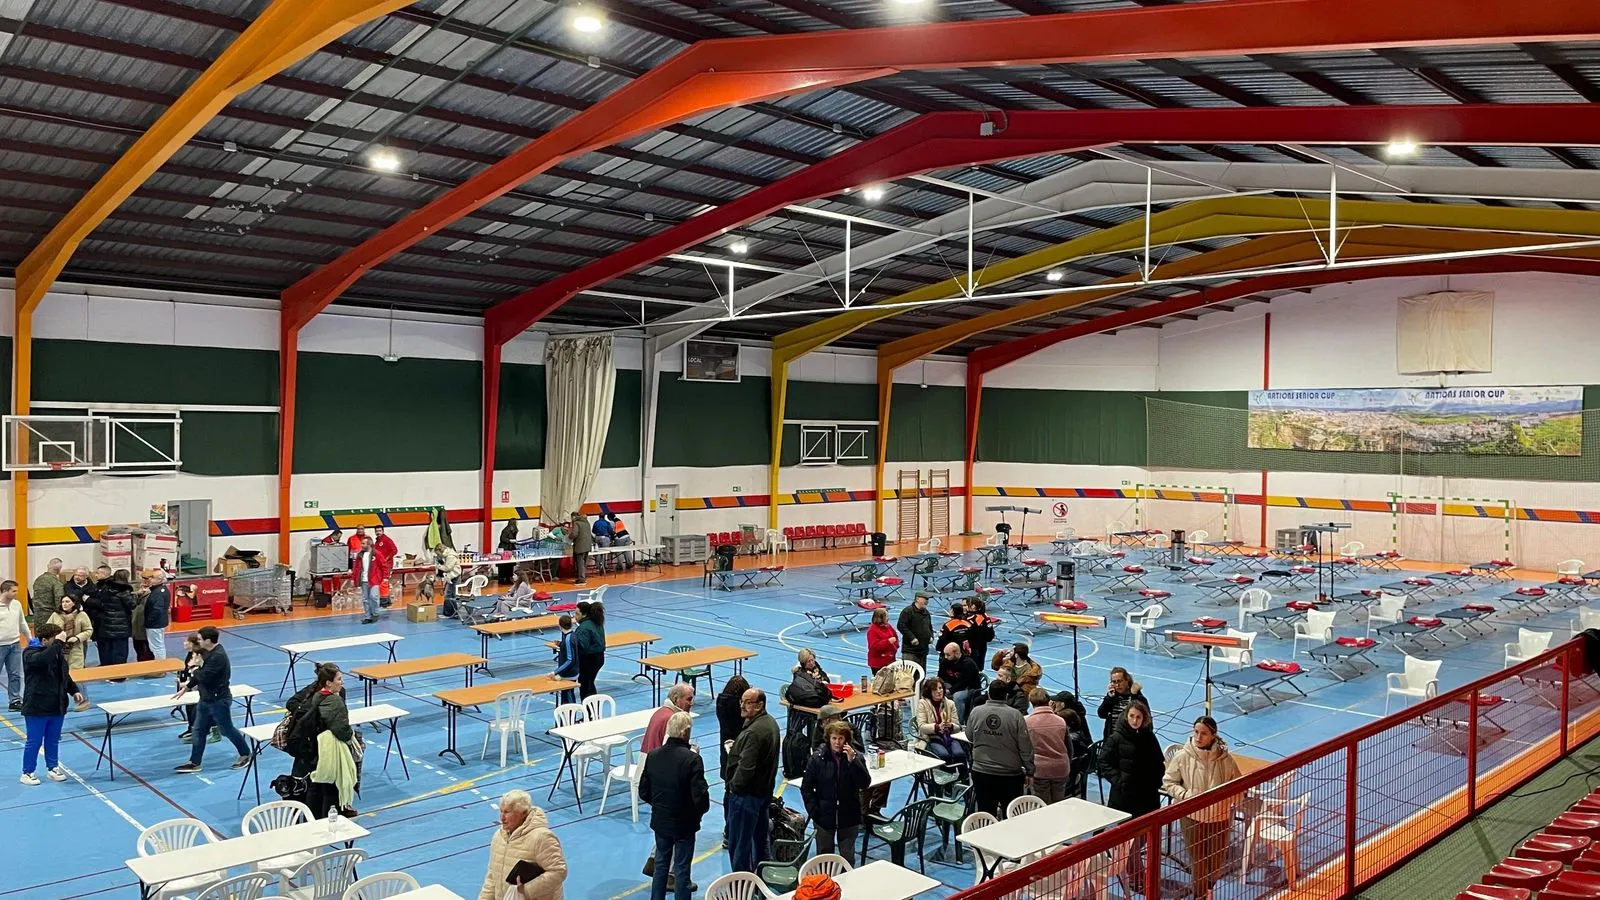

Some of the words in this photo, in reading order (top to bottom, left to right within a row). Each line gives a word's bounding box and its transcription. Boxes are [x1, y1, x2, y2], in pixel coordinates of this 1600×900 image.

[1267, 391, 1295, 399] NATIONS
[1296, 391, 1319, 399] SENIOR
[1320, 391, 1336, 399] CUP
[1425, 390, 1457, 399] NATIONS
[1458, 390, 1486, 398] SENIOR
[1487, 390, 1505, 398] CUP
